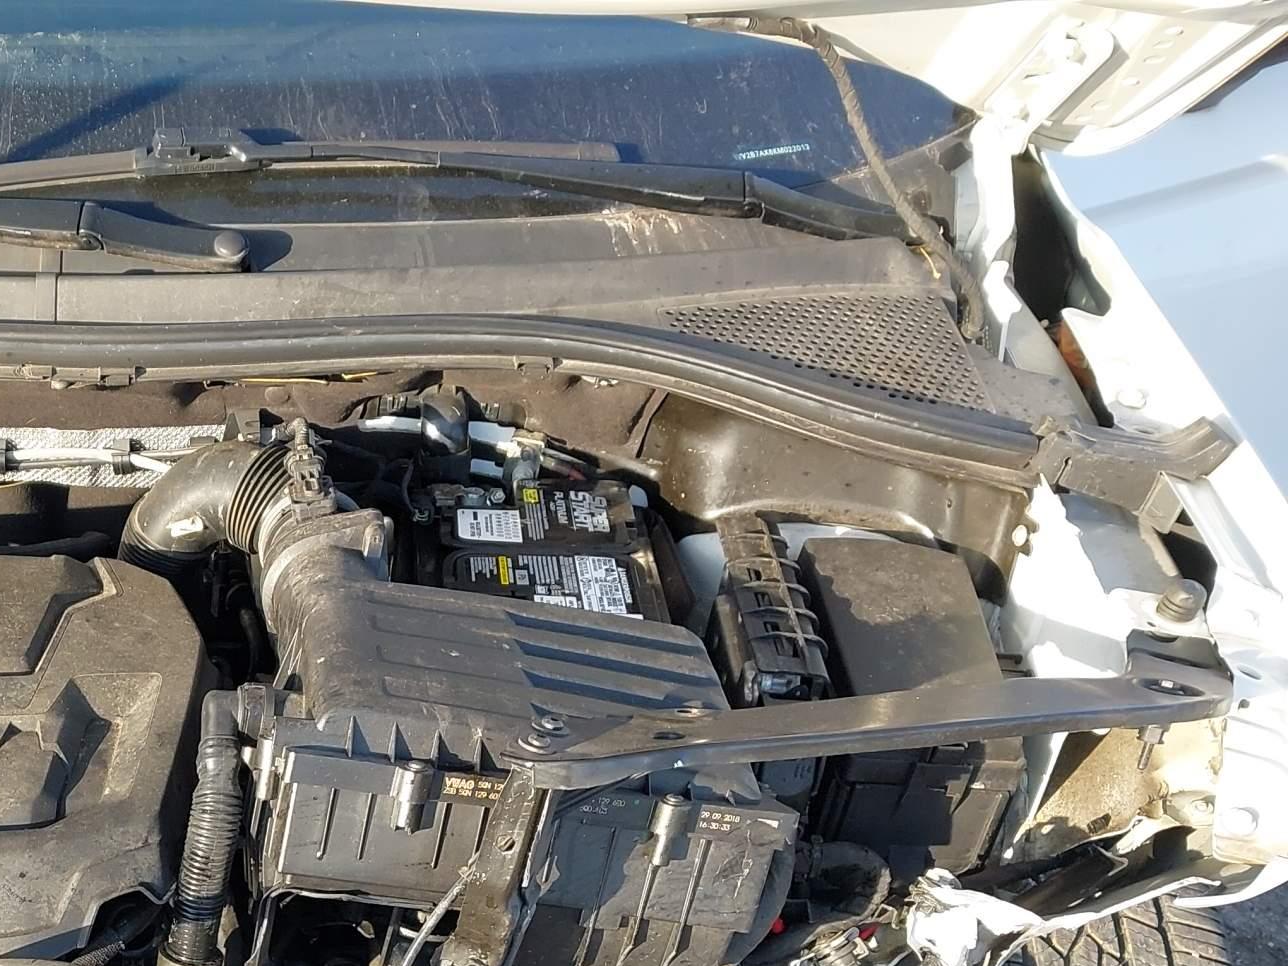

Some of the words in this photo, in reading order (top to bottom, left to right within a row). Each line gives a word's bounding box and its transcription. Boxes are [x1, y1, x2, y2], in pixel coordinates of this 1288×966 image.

[553, 491, 569, 524] PLATINUM
[569, 490, 594, 533] START
[591, 496, 610, 533] SUPER
